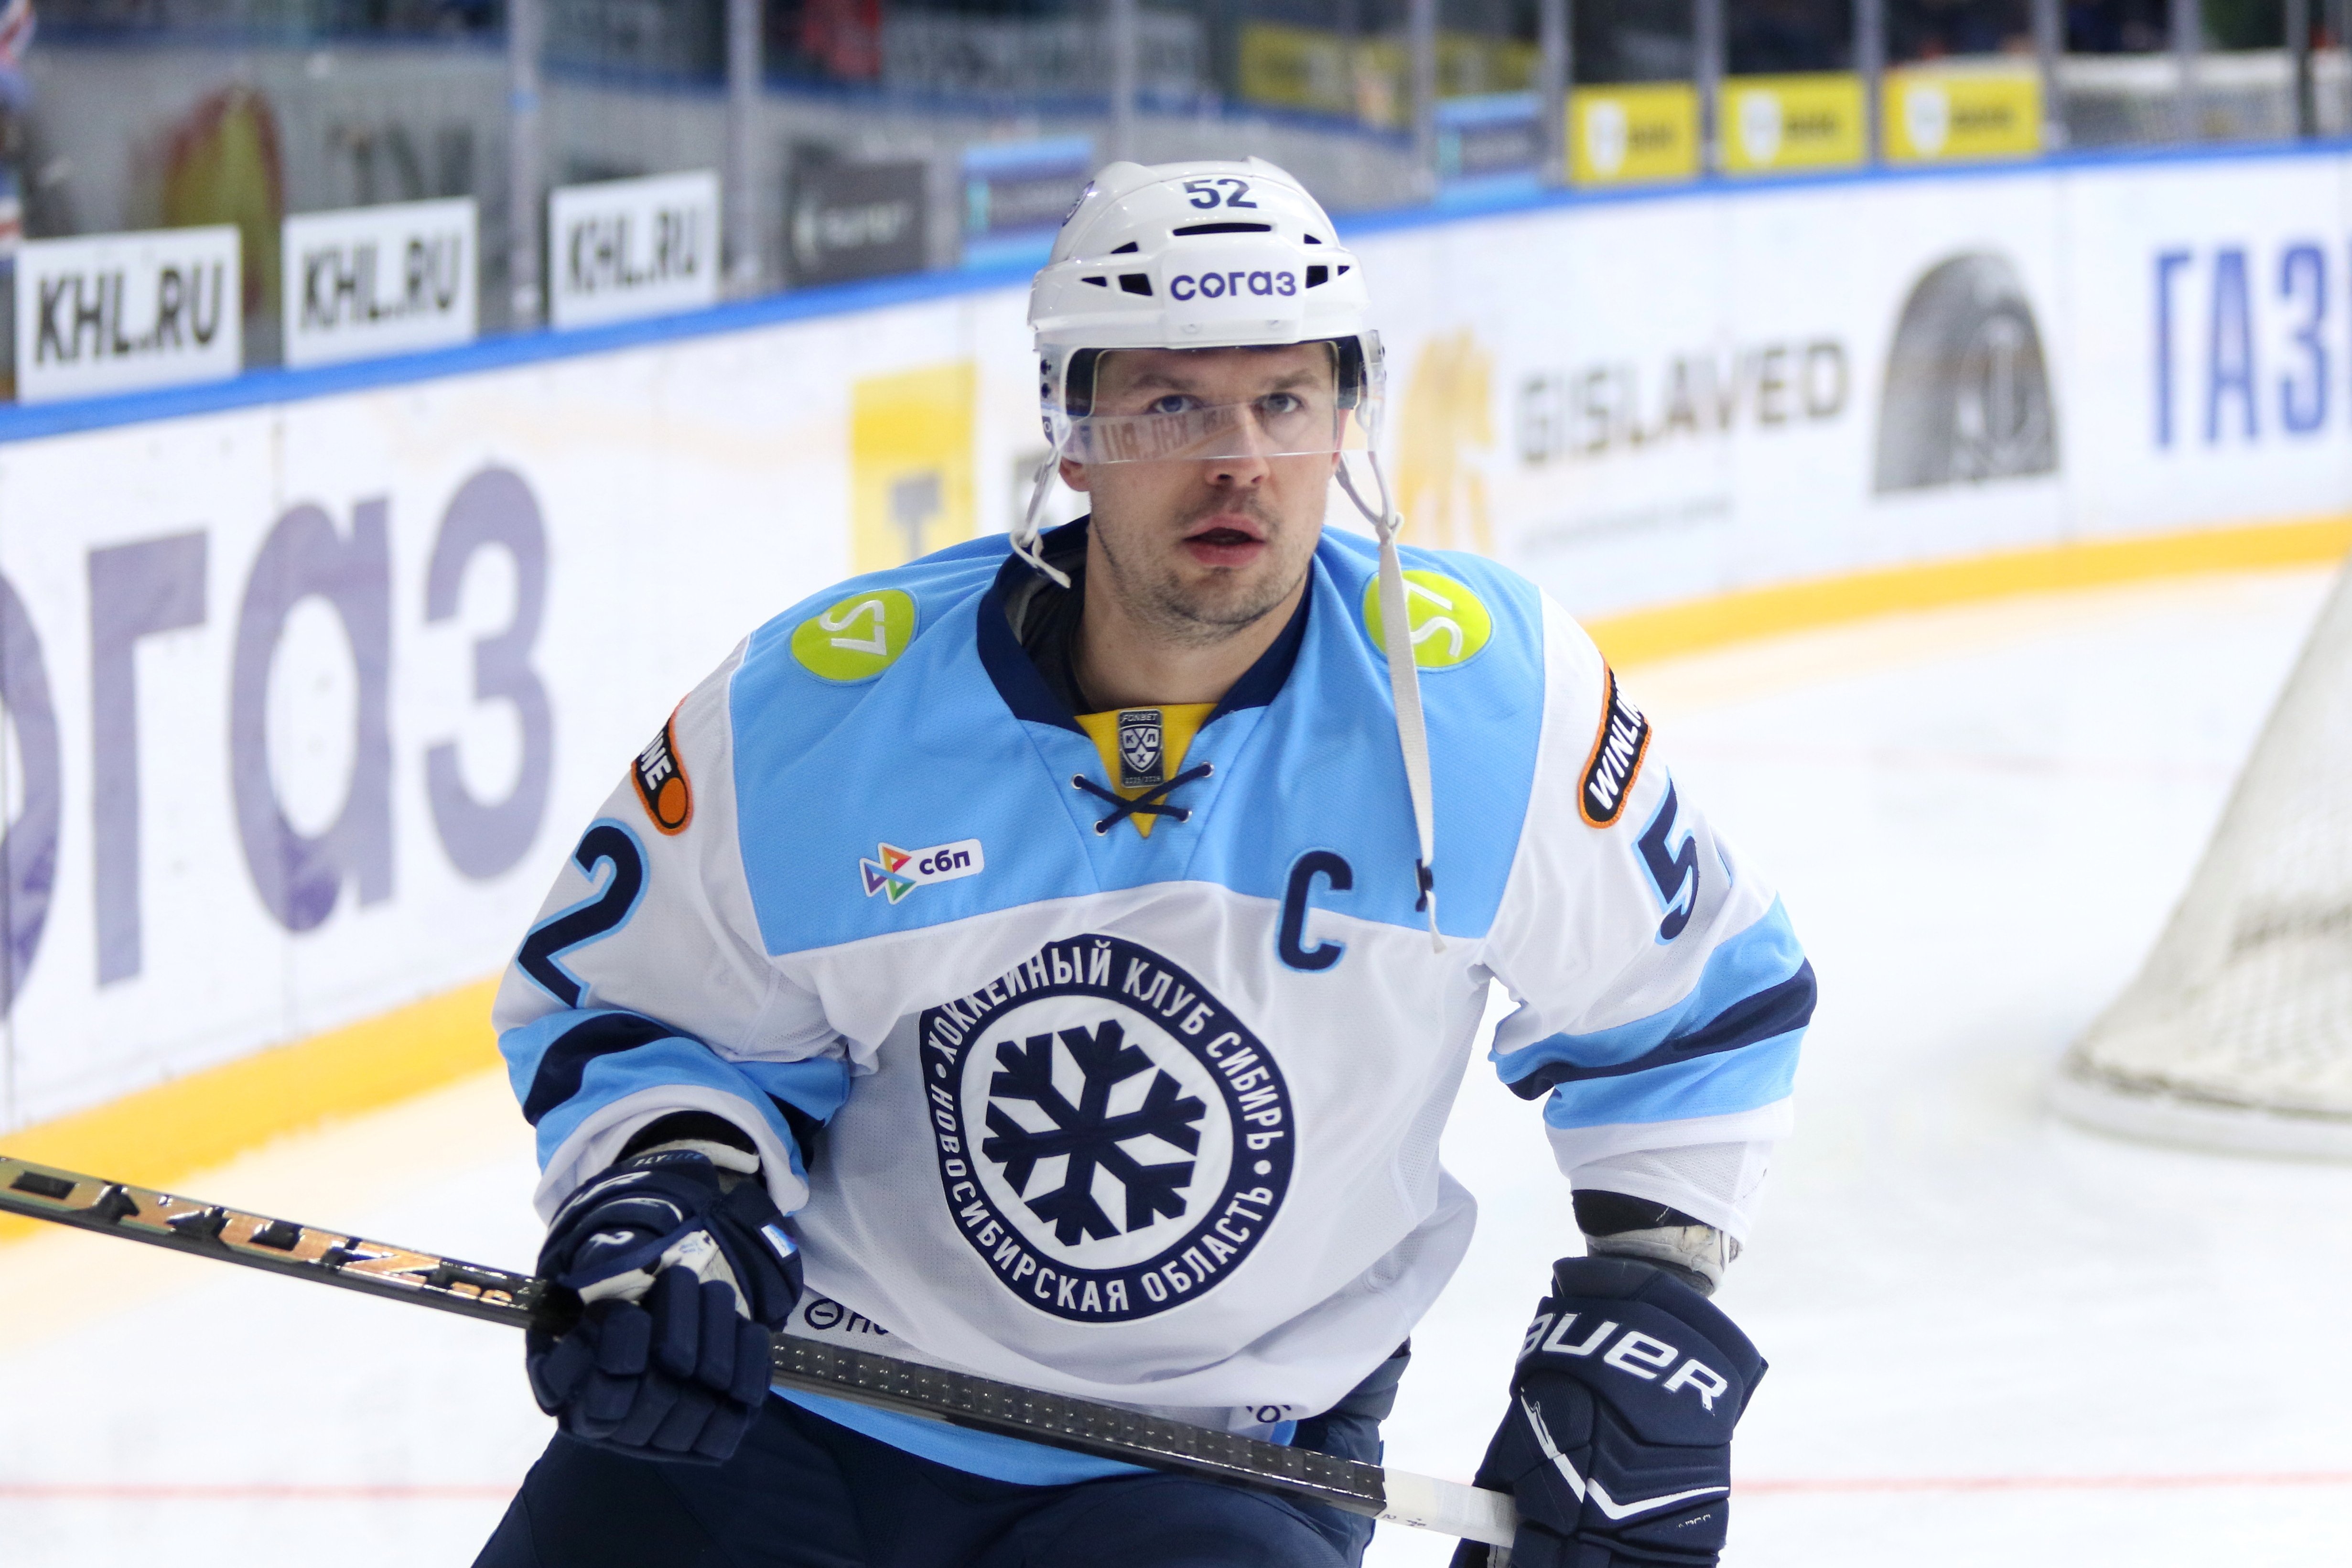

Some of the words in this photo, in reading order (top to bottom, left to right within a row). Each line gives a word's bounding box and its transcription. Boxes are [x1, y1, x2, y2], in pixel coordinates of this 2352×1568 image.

[1183, 179, 1258, 209] 52
[302, 235, 461, 329] KHL.RU
[568, 205, 697, 295] KHL.RU
[1170, 271, 1296, 301] согаз
[37, 261, 224, 362] KHL.RU
[2153, 243, 2352, 445] ГАЗ
[1519, 337, 1847, 469] GISLAVED
[919, 849, 971, 875] сбп
[1634, 767, 1708, 945] 5
[1122, 957, 1215, 1035] КЛУБ
[1206, 1031, 1284, 1150] СИБИРЬ
[931, 1083, 1129, 1312] НОВОСИБИРСКАЯ
[1141, 1187, 1273, 1302] ОБЛАСТЬ
